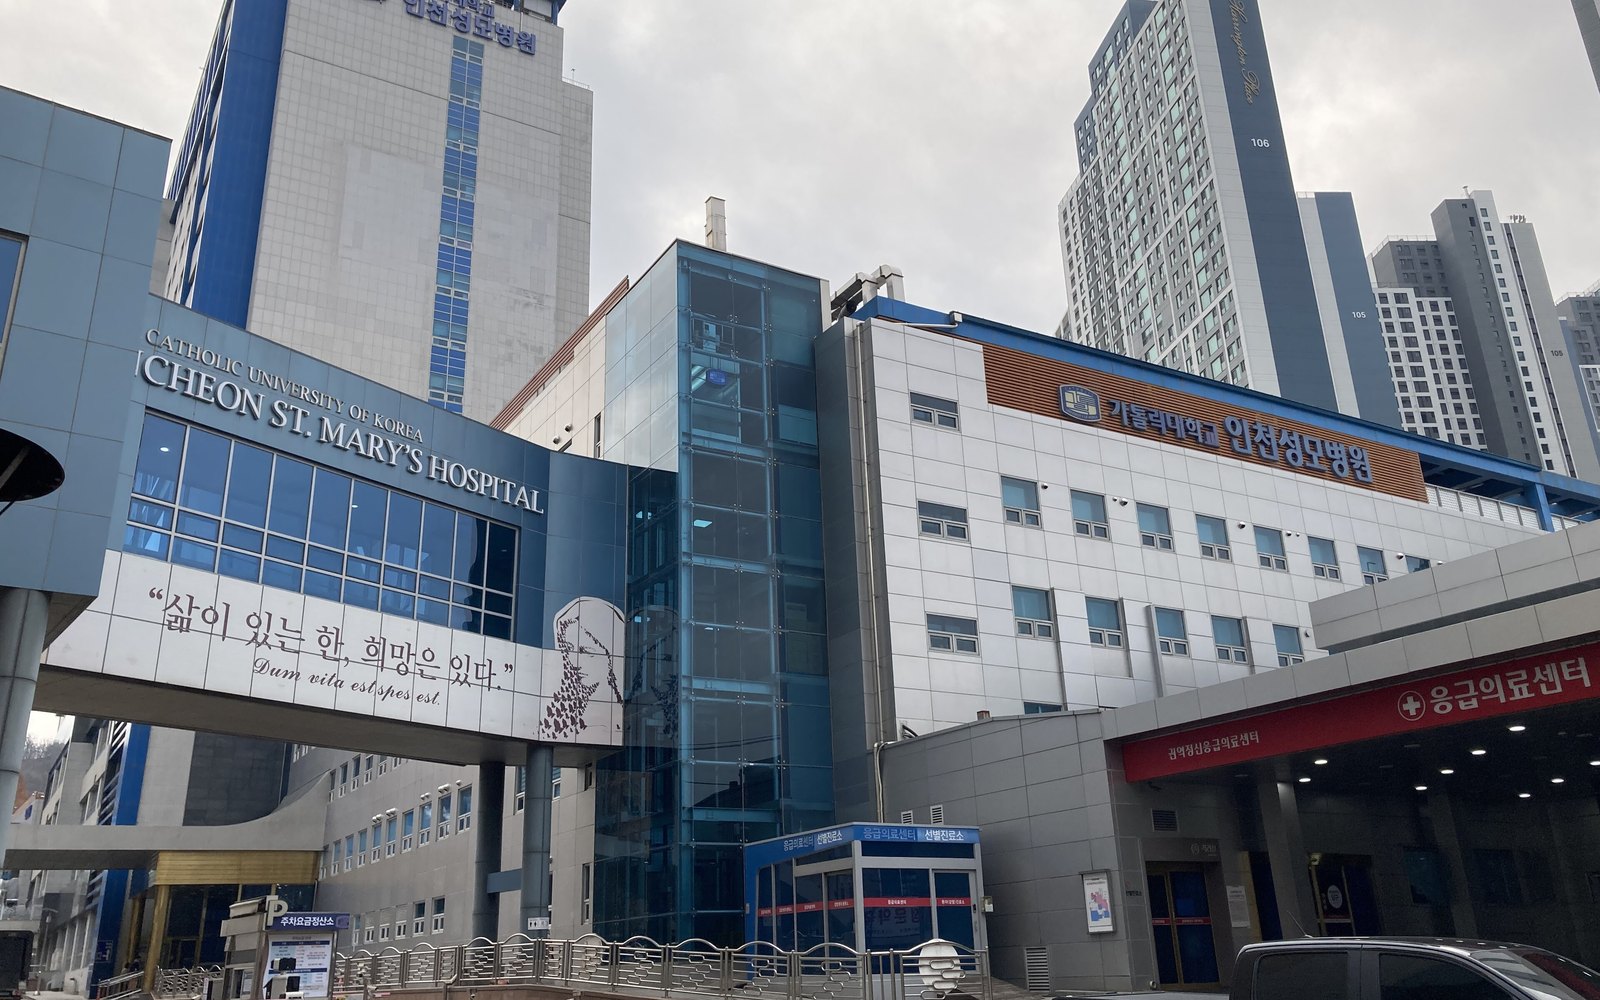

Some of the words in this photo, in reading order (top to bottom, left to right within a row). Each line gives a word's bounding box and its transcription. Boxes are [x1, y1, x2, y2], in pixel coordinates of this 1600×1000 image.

[1251, 138, 1270, 148] 106
[1352, 311, 1366, 319] 105
[146, 329, 244, 377] CATHOLIC
[249, 366, 345, 414] UNIVERSITY
[349, 404, 369, 423] OF
[373, 413, 424, 443] KOREA
[1107, 399, 1220, 448] 가톨릭대학교
[1224, 415, 1373, 483] 인천성모병원
[269, 400, 312, 437] ST.
[426, 453, 544, 514] HOSPITAL
[245, 611, 305, 653] 있는
[316, 625, 350, 667] 한,
[361, 635, 441, 680] 희망은
[254, 657, 301, 682] Dum
[308, 672, 345, 689] vita
[1430, 657, 1592, 714] 응급의료센터
[1168, 730, 1260, 760] 권역정신응급의료센터
[863, 827, 916, 841] 응급의료센터
[924, 830, 964, 841] 선별진료소
[266, 899, 288, 926] P
[280, 916, 334, 926] 주차요금정산소
